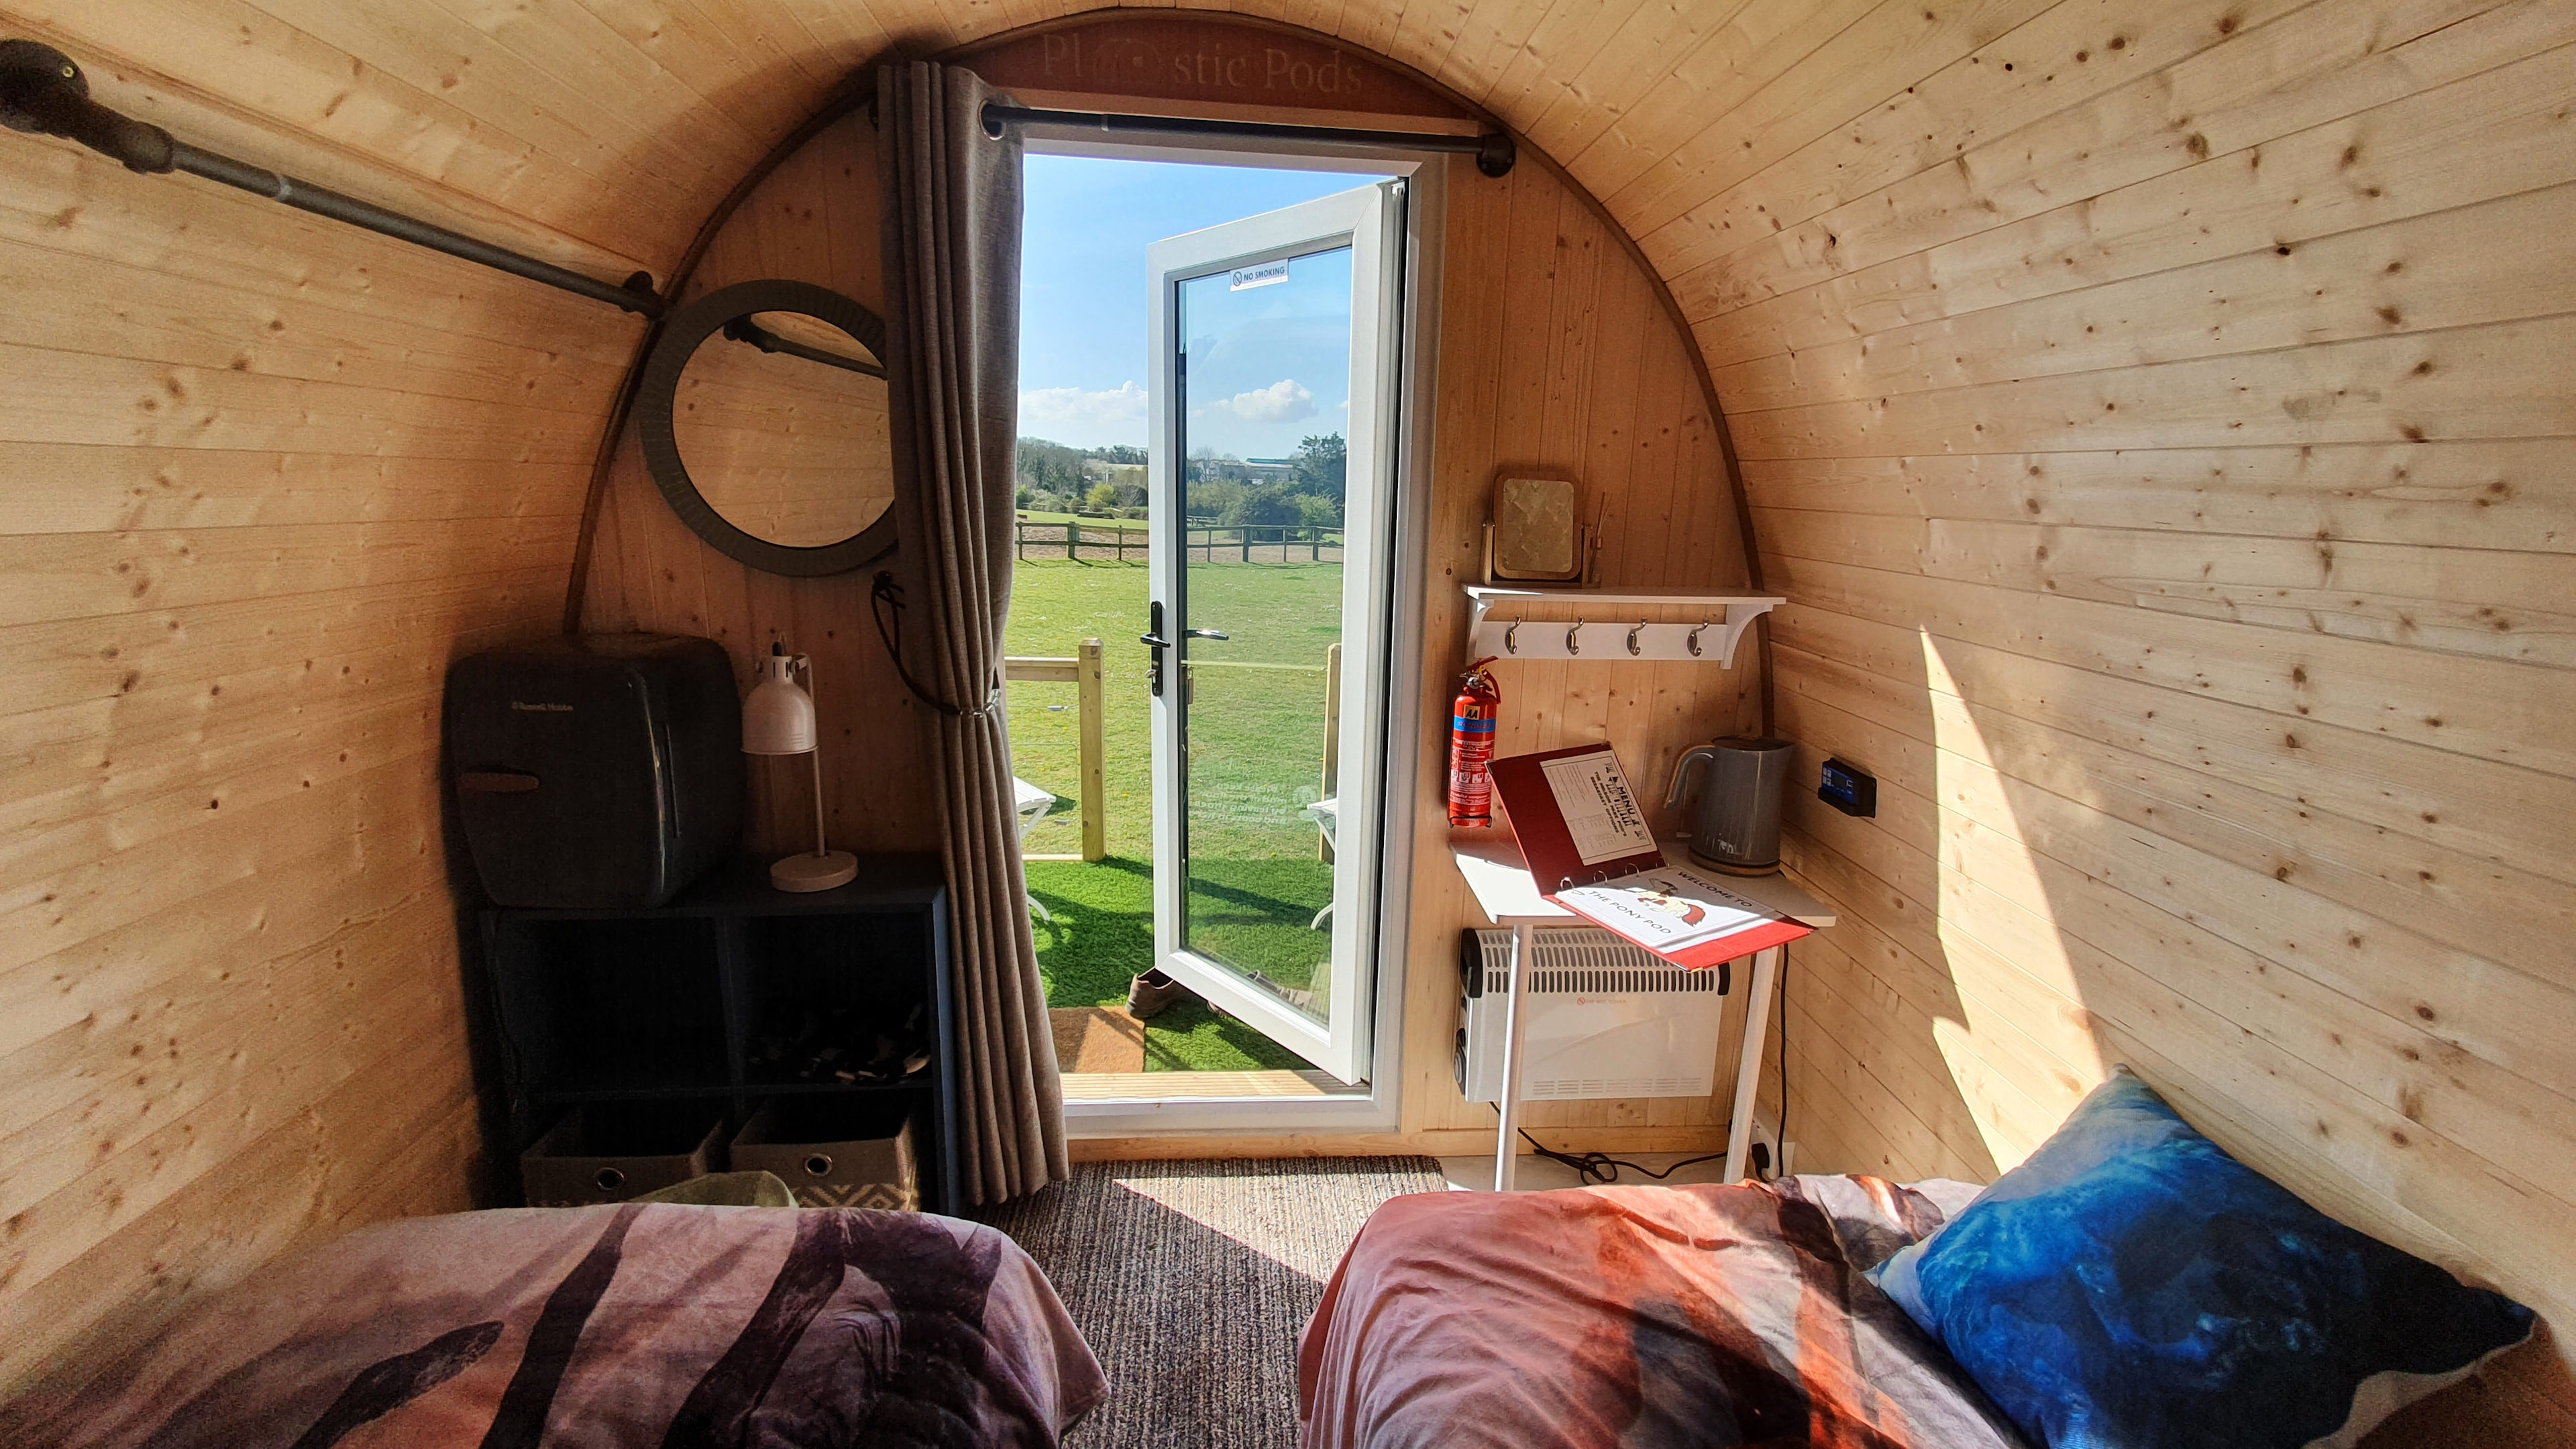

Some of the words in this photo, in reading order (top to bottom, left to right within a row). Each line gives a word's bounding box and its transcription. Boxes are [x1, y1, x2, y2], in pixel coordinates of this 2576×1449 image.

[1264, 46, 1362, 94] Pods
[1244, 273, 1253, 281] NO
[1255, 266, 1285, 278] SMOKING
[1465, 709, 1478, 718] AA
[1617, 786, 1636, 815] MENU
[1678, 871, 1734, 899] WELCOME
[1734, 898, 1752, 907] TO
[1589, 891, 1611, 902] THE
[1610, 902, 1646, 919] PONY
[1643, 920, 1672, 933] POD
